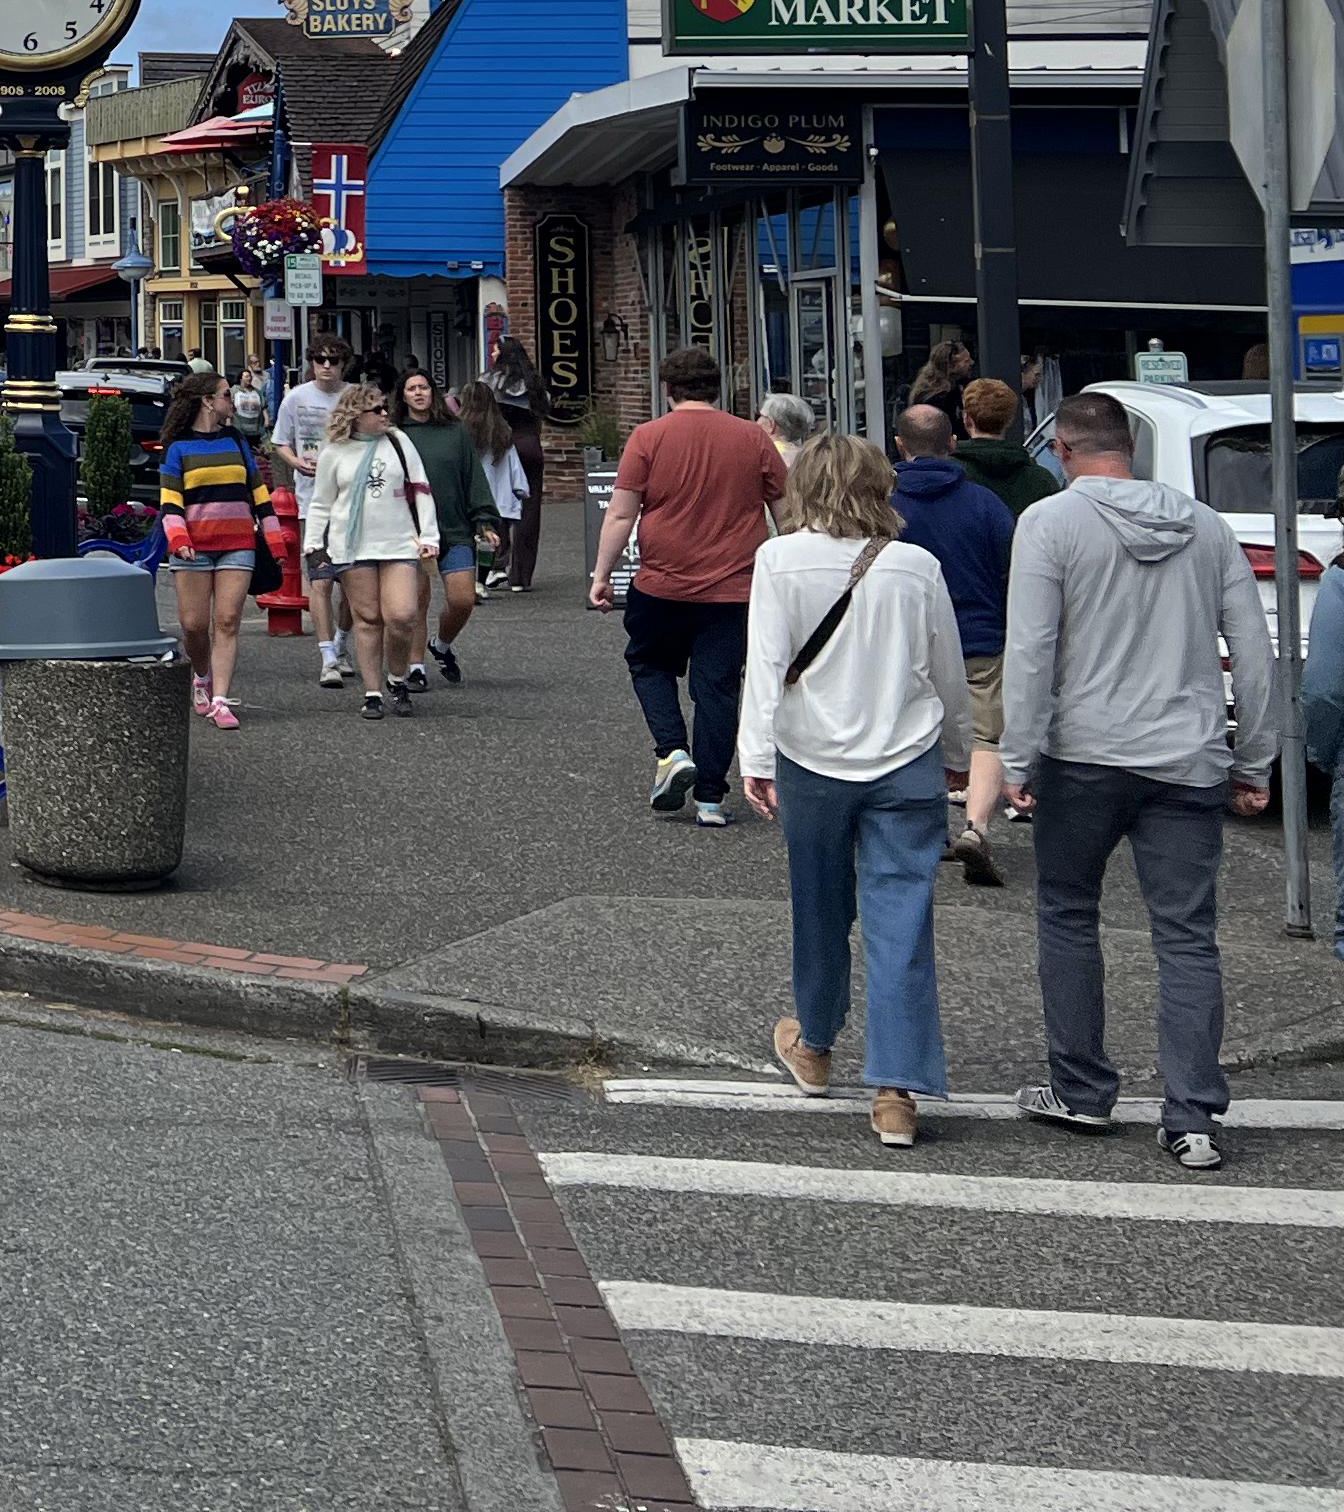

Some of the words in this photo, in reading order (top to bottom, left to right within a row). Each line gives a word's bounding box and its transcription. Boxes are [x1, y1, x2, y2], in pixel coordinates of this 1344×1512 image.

[64, 21, 77, 39] 5
[310, 13, 387, 33] BAKERY
[23, 32, 38, 50] 6
[34, 86, 66, 96] 2008
[703, 114, 779, 128] INDIGO
[789, 114, 845, 128] PLUM
[710, 163, 754, 171] Footwear
[762, 163, 800, 172] Apparel
[808, 163, 838, 171] Goods
[547, 236, 579, 388] SHOES
[431, 322, 445, 386] SHOES
[1140, 360, 1182, 370] RESERVED
